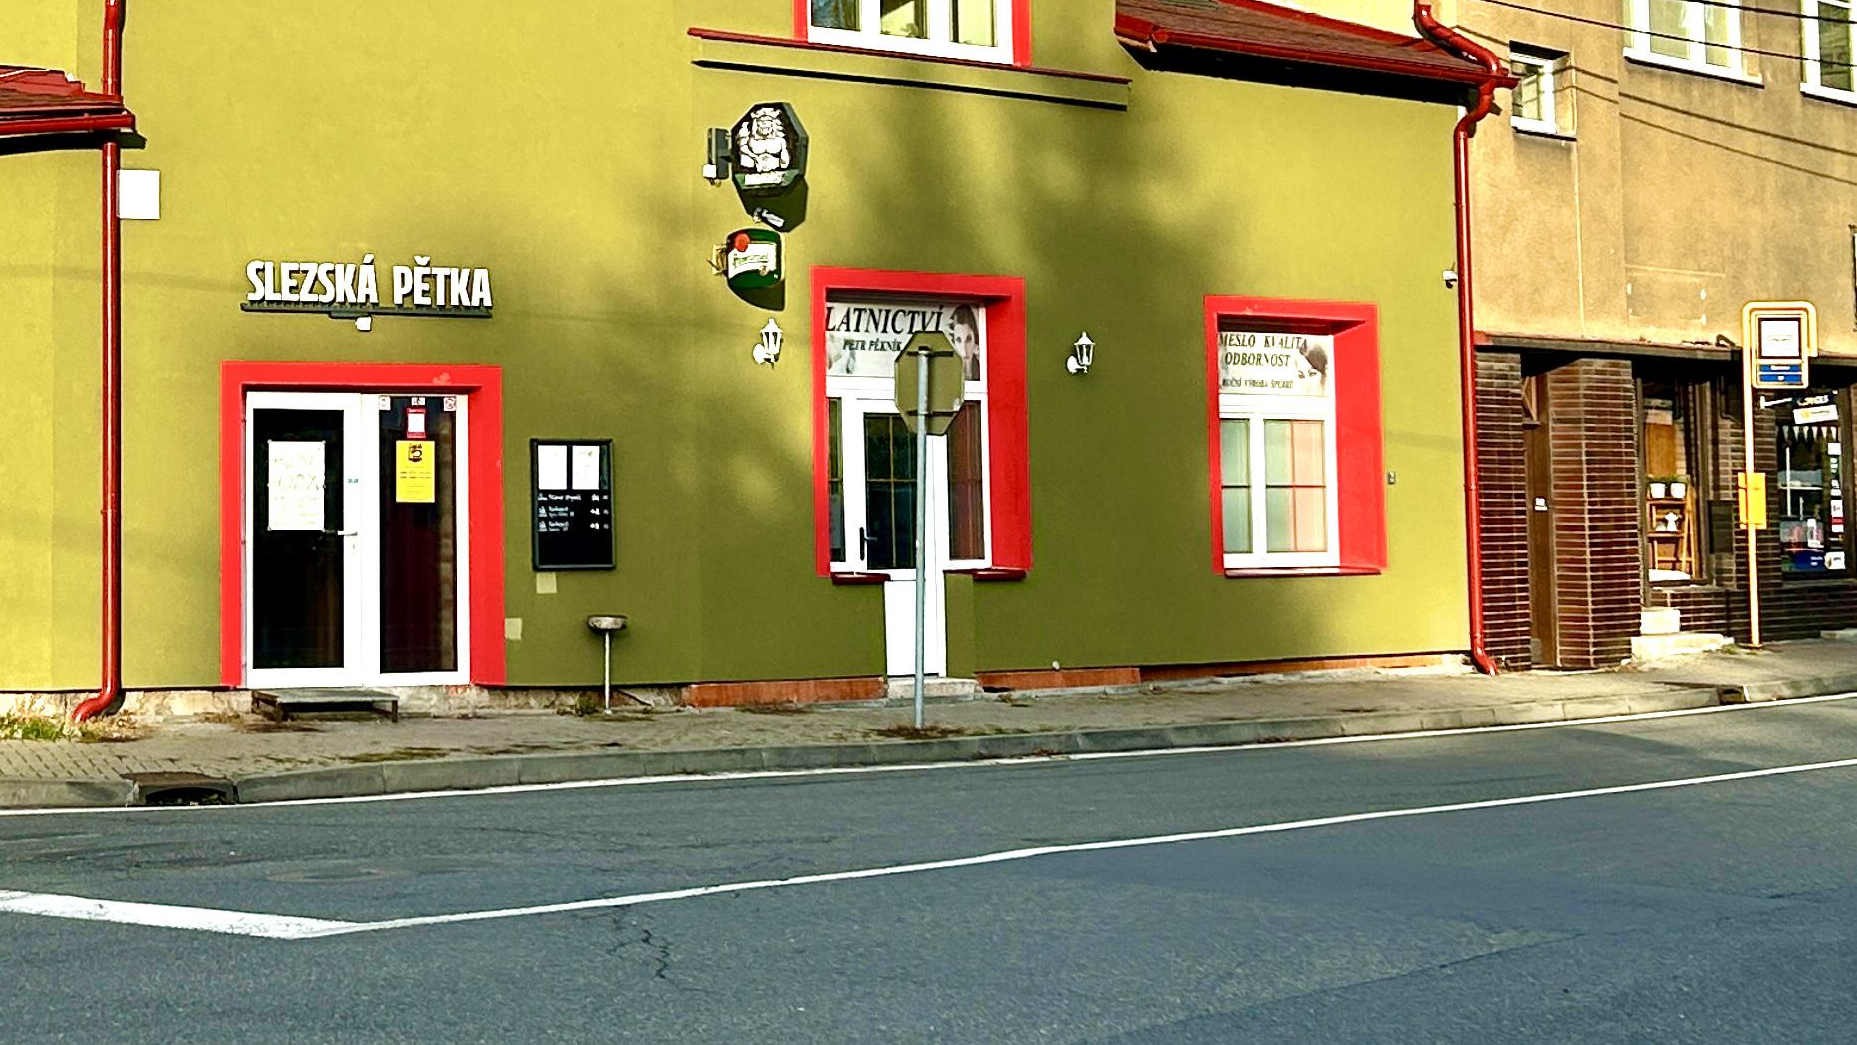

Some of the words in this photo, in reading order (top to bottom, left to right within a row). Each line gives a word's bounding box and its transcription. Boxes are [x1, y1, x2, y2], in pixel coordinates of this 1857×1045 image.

[246, 253, 379, 303] SLEZSKÁ
[392, 255, 493, 308] PĚTKA
[842, 338, 866, 351] PETR
[1264, 335, 1308, 351] KVALITA
[1225, 351, 1291, 367] ODBORNOST
